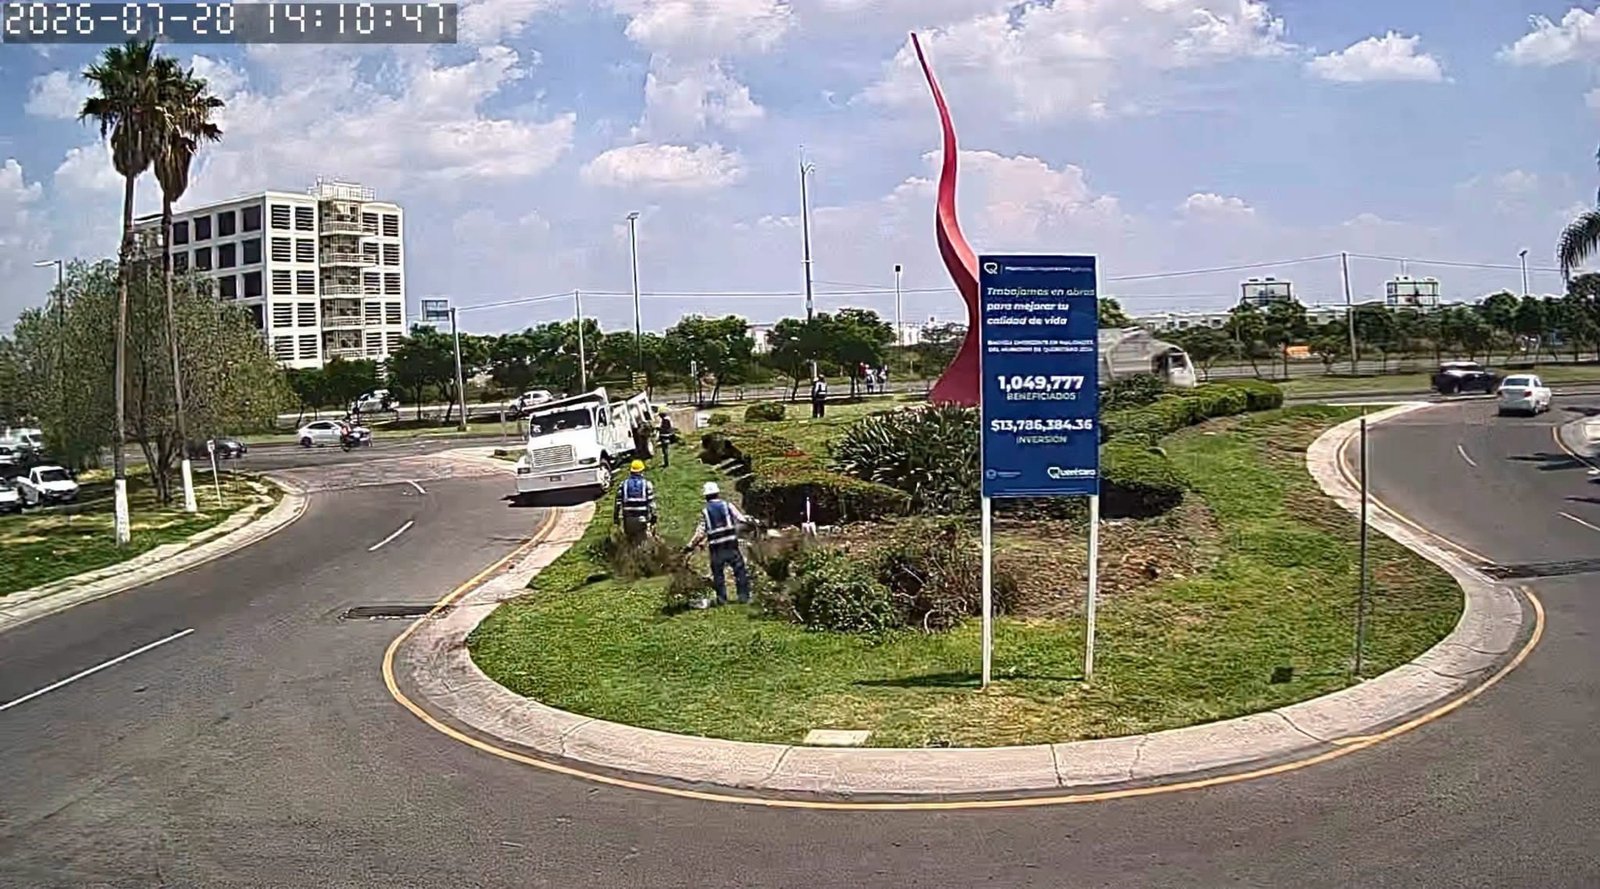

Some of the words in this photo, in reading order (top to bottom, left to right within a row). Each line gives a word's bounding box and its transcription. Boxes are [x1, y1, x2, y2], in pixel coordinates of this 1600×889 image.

[986, 287, 1049, 298] Trabajamos
[1050, 288, 1064, 296] en
[1066, 287, 1095, 296] obras
[986, 303, 1012, 312] para
[1013, 301, 1057, 312] mejorar
[1057, 302, 1069, 311] tu
[986, 316, 1028, 325] calidad
[1028, 316, 1042, 325] de
[1044, 316, 1068, 325] vida
[997, 375, 1085, 392] 1,049,777
[1006, 392, 1076, 400] BENEFICIADOS
[990, 419, 1093, 433] $13,786,384.36
